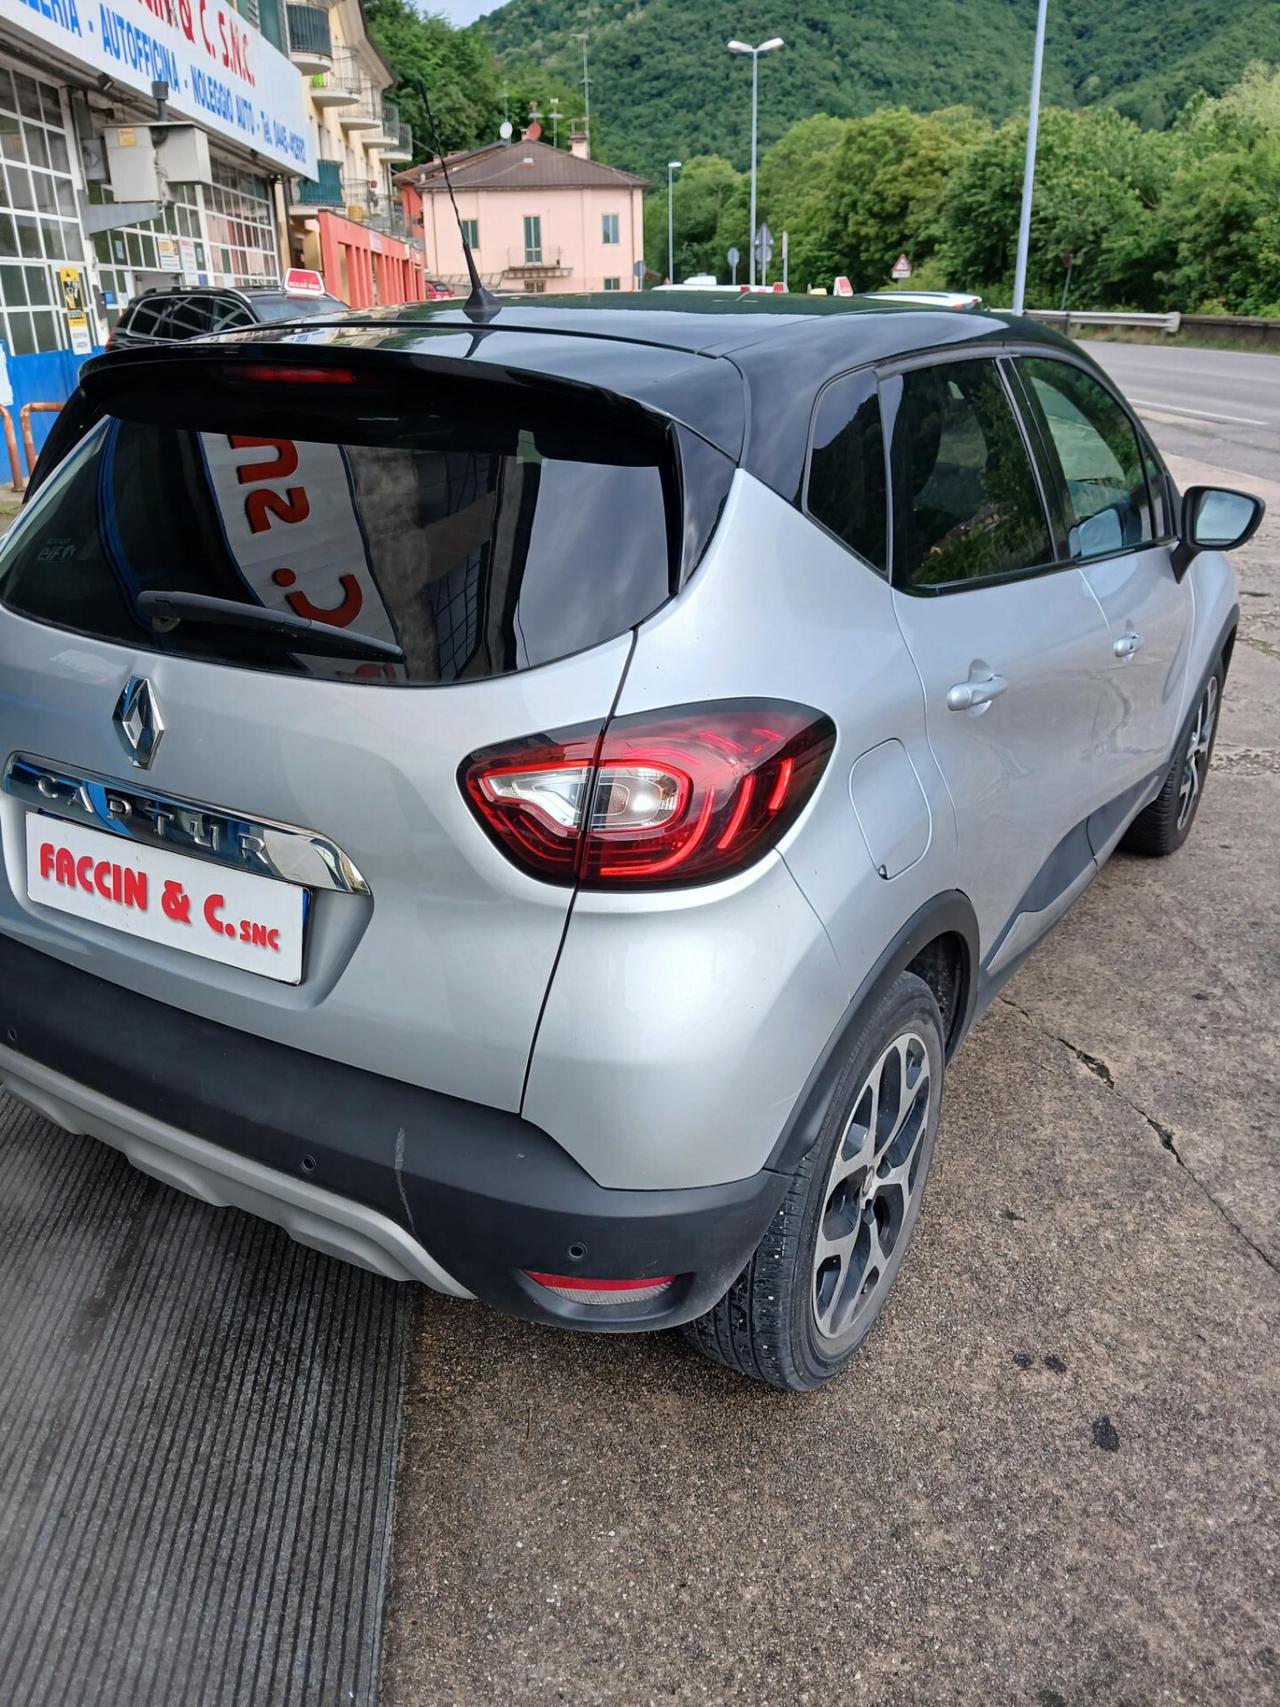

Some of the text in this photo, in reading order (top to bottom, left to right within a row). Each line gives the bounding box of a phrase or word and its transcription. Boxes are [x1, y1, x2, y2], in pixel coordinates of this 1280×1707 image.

[99, 3, 180, 93] AUTOFFICINA
[190, 64, 234, 123] NOLEGGIO
[236, 94, 255, 135] AUTO
[38, 775, 269, 865] CAPTUR
[39, 842, 148, 911] FACCIN
[161, 879, 191, 925] &
